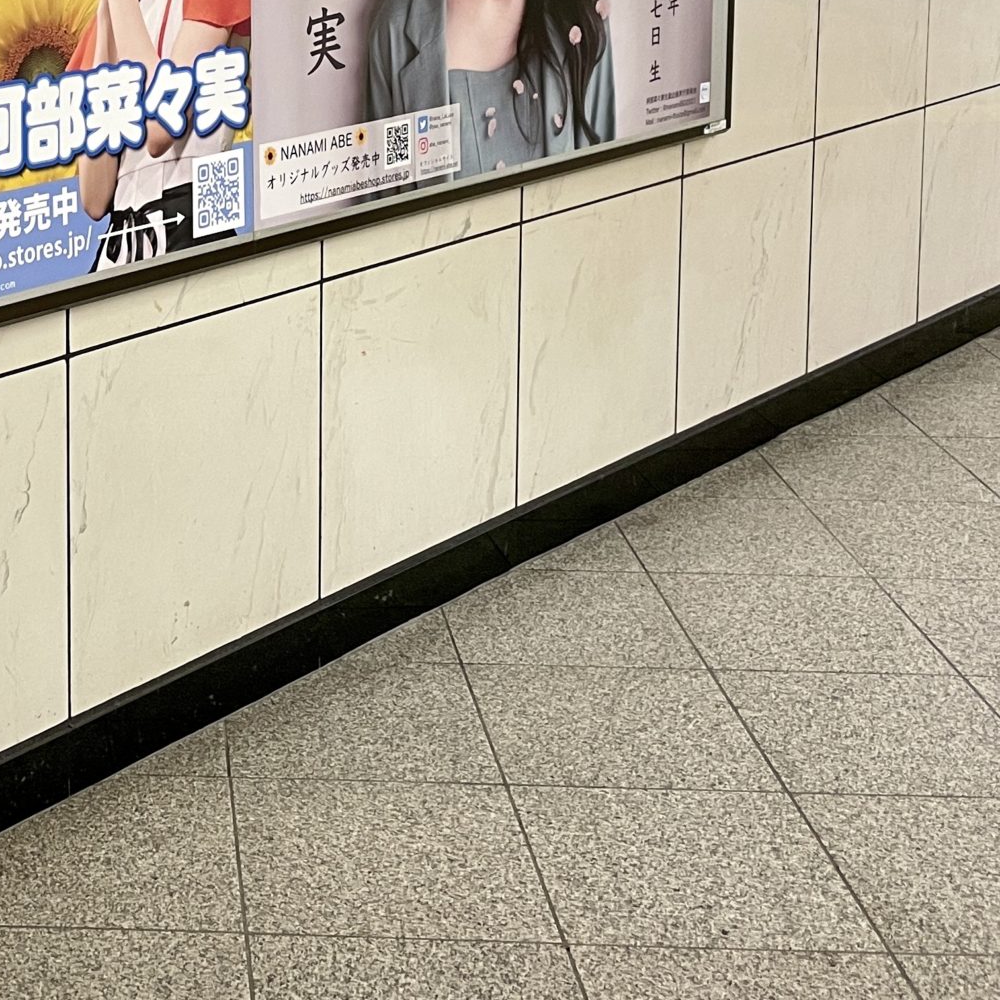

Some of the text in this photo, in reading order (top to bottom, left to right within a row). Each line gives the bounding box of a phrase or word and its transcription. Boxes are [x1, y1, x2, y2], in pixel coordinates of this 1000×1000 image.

[280, 132, 353, 161] NANAMI ABE
[267, 151, 381, 190] オリジナルグッズ発売中
